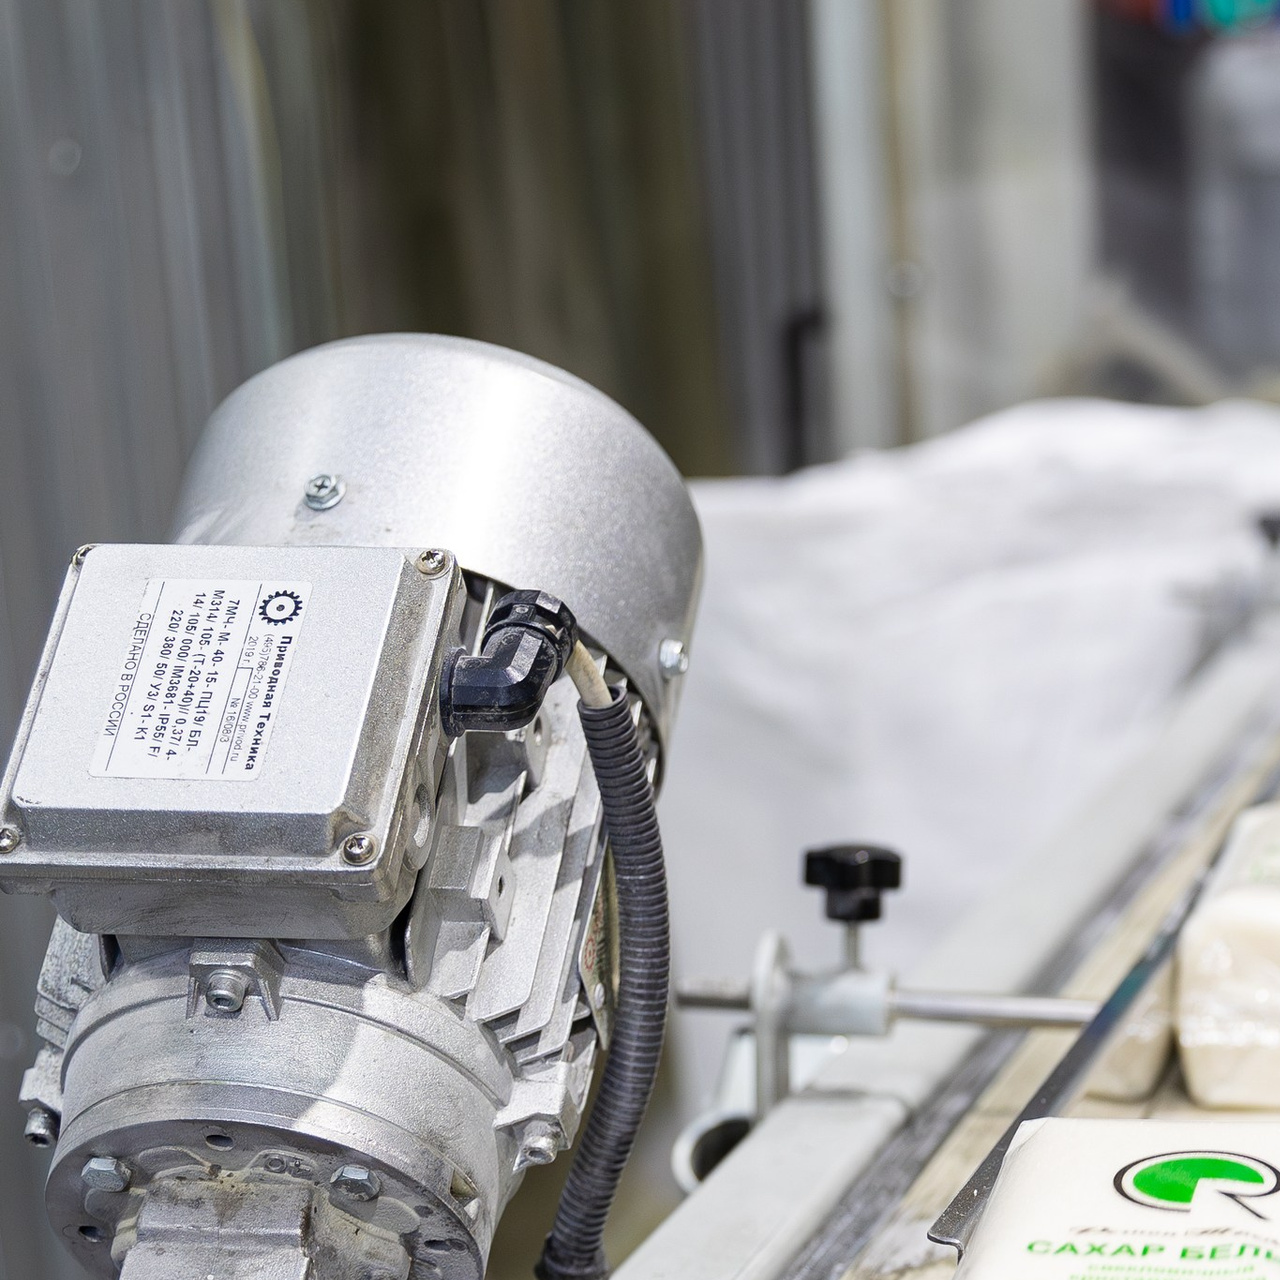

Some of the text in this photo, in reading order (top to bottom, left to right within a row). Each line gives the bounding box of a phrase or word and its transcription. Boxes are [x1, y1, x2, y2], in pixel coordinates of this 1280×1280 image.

[192, 592, 207, 609] 14/
[206, 590, 226, 623] М314/
[167, 609, 184, 633] 220/
[184, 612, 201, 636] 105/
[159, 636, 176, 660] 380/
[176, 638, 193, 662] 000/
[198, 627, 214, 650] 105-
[217, 632, 231, 646] М-
[244, 635, 259, 658] 2019
[211, 649, 225, 667] 40-
[247, 633, 275, 700] (495)786-21-00
[103, 613, 152, 736] СДЕЛАНО В РОССИИ
[152, 662, 168, 680] 50/
[205, 670, 219, 688] 15-
[140, 704, 156, 724] S1-
[193, 691, 213, 727] ПЦ19/
[244, 635, 293, 770] Приводная Техника
[219, 697, 241, 743] № 16/08/3
[169, 718, 187, 746] 0,37/
[186, 729, 202, 752] БЛ-
[147, 746, 161, 758] F/
[165, 749, 177, 761] 4-
[1027, 1238, 1166, 1258] САХАР
